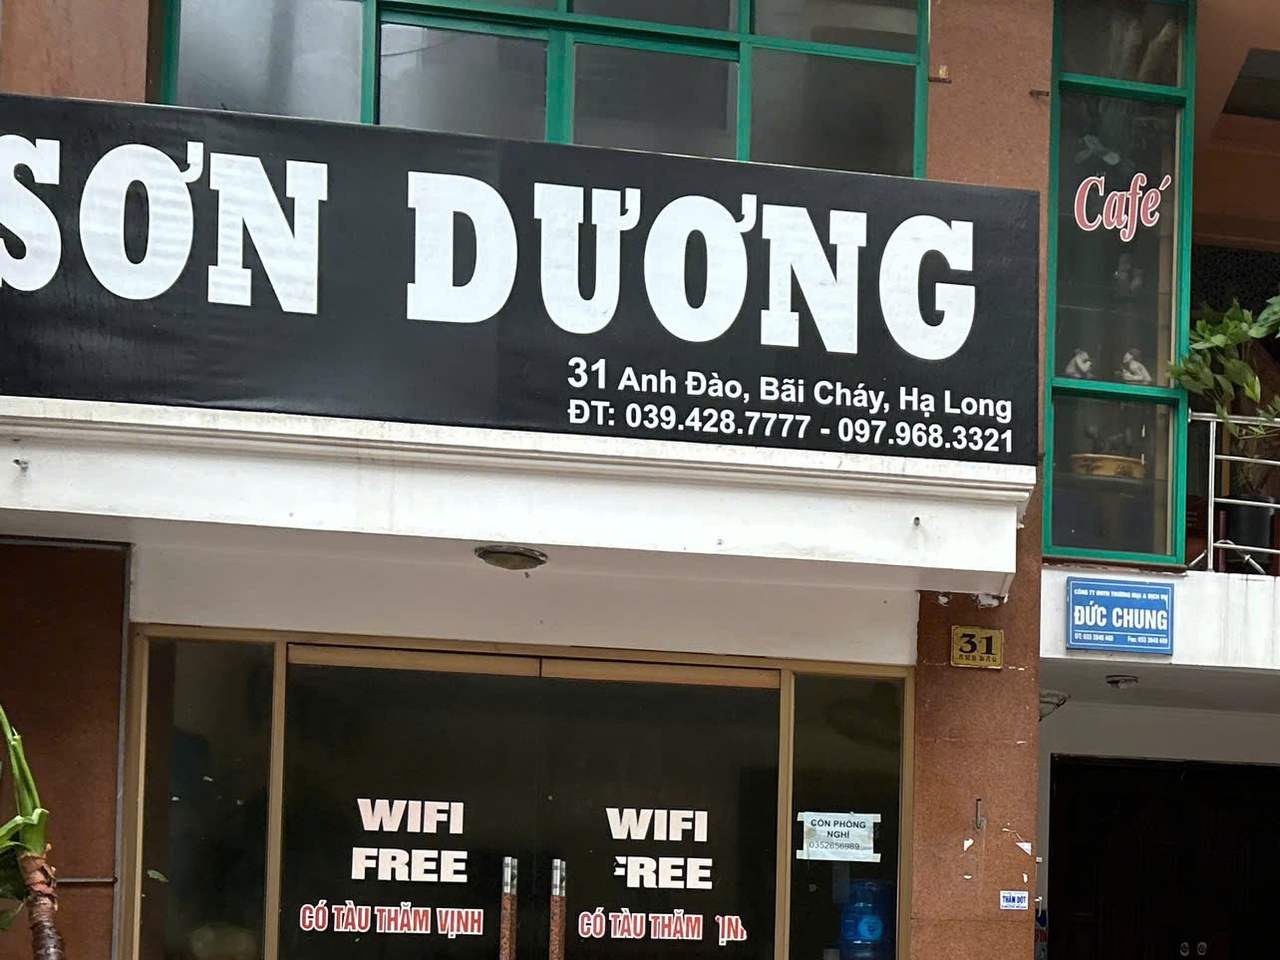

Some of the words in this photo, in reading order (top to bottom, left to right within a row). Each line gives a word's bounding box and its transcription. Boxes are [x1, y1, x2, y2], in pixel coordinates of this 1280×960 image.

[1074, 172, 1172, 242] Café
[0, 134, 328, 315] SƠN
[407, 171, 976, 361] DƯƠNG
[567, 356, 606, 389] 31
[617, 366, 677, 394] Anh
[685, 371, 750, 403] Đào,
[760, 376, 805, 403] Bãi
[813, 380, 890, 414] Cháy,
[899, 386, 935, 418] Hạ
[944, 390, 1012, 424] Long
[567, 399, 615, 426] ĐT:
[625, 402, 811, 439] 039.428.7777
[837, 417, 1013, 453] 097.968.3321
[1074, 600, 1107, 627] ĐỨC
[1112, 607, 1168, 630] CHUNG
[959, 633, 997, 655] 31
[357, 798, 464, 834] WIFI
[605, 807, 708, 842] WIFI
[351, 847, 468, 883] FREE
[300, 899, 328, 931] CÓ
[332, 900, 371, 932] TÀU
[374, 901, 432, 934] THĂM
[436, 907, 484, 939] VỊNH
[578, 907, 606, 938] CÓ
[609, 907, 646, 939] TÀU
[649, 909, 703, 940] THĂM
